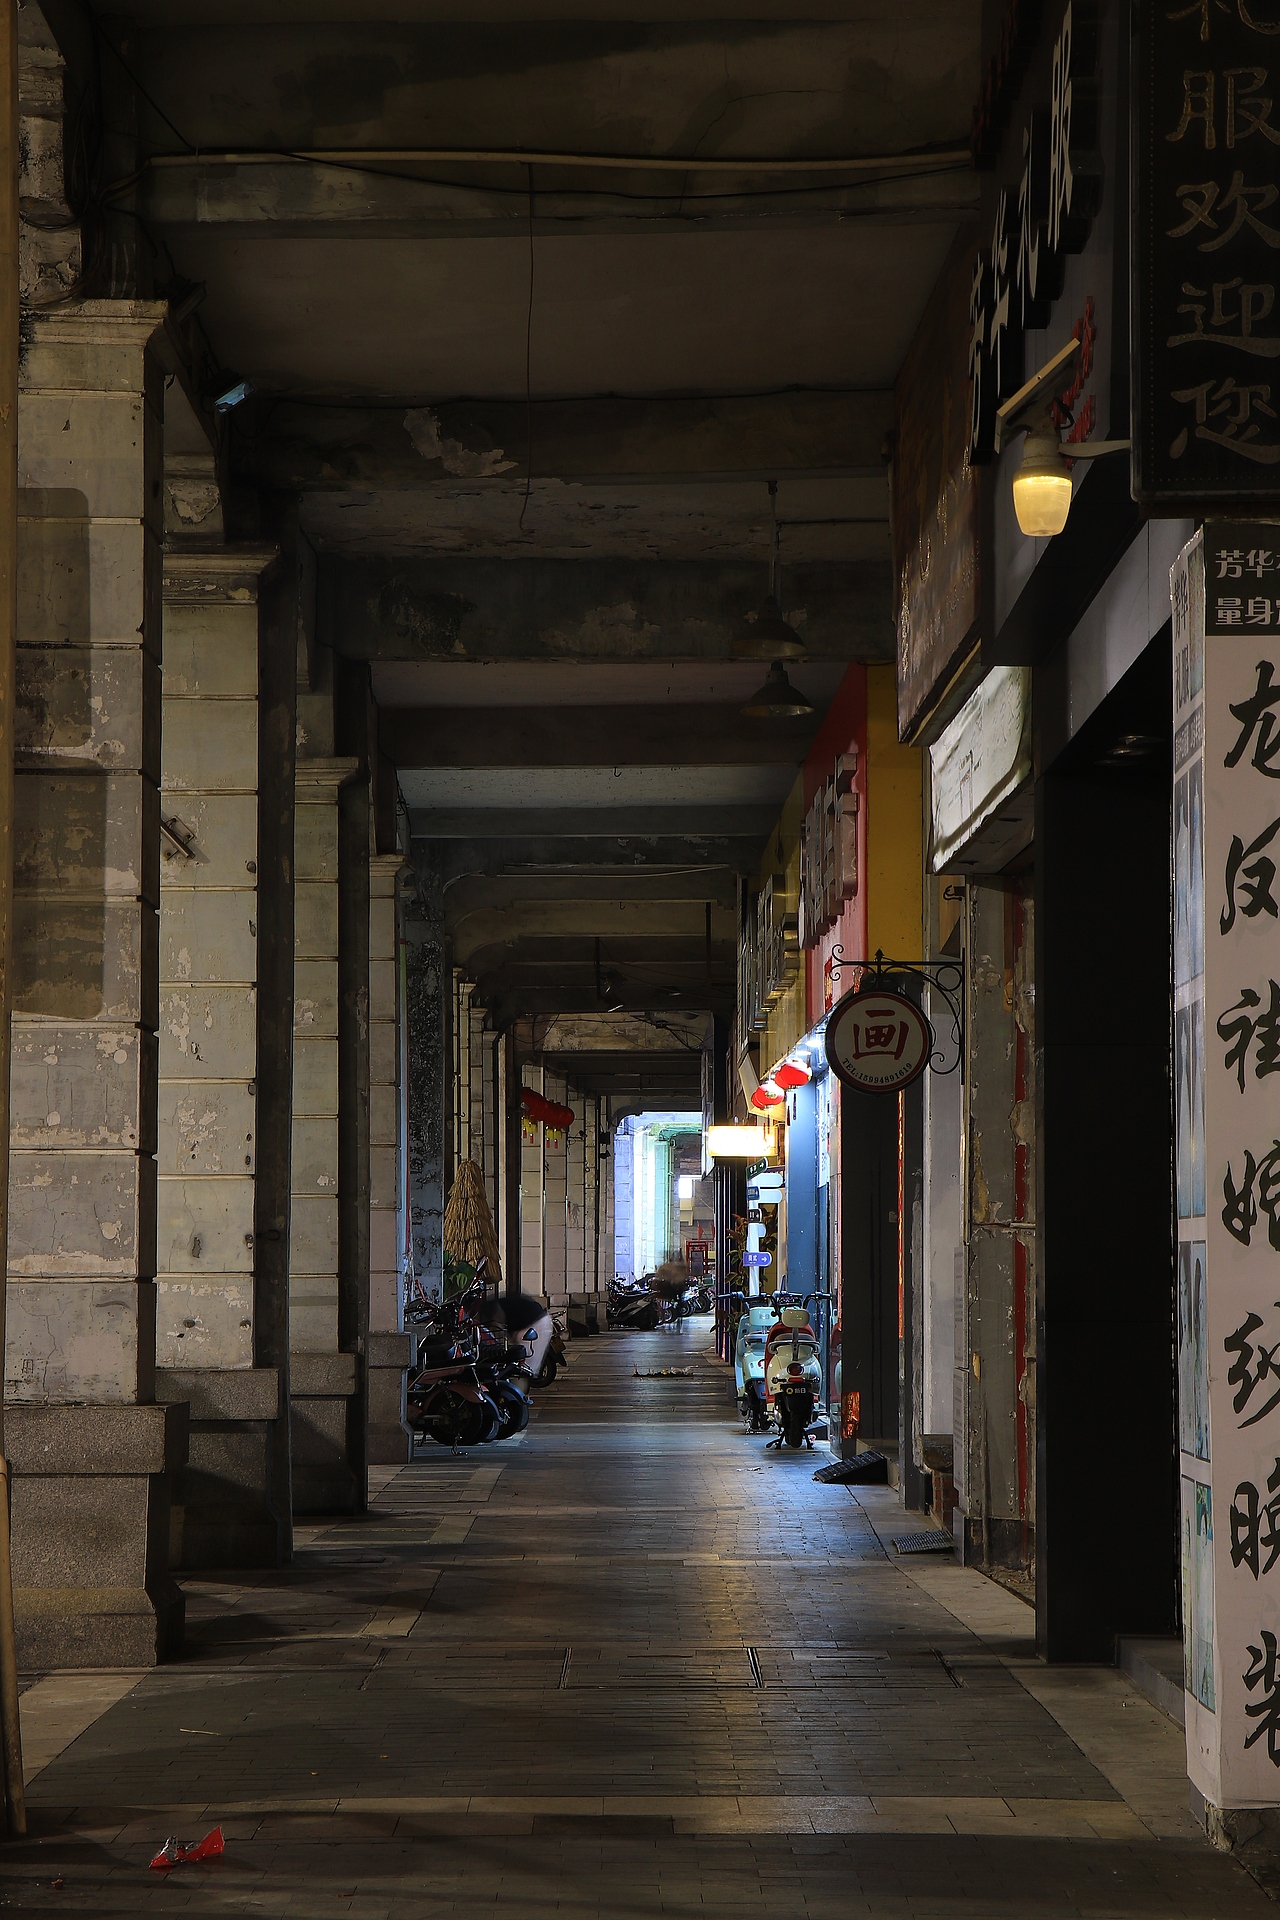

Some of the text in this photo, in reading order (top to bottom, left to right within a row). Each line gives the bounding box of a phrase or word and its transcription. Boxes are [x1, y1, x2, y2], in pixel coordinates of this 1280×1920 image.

[969, 0, 1074, 463] 芳华礼服
[1215, 549, 1280, 578] 芳华
[1215, 597, 1280, 625] 量身
[853, 1009, 910, 1061] 画
